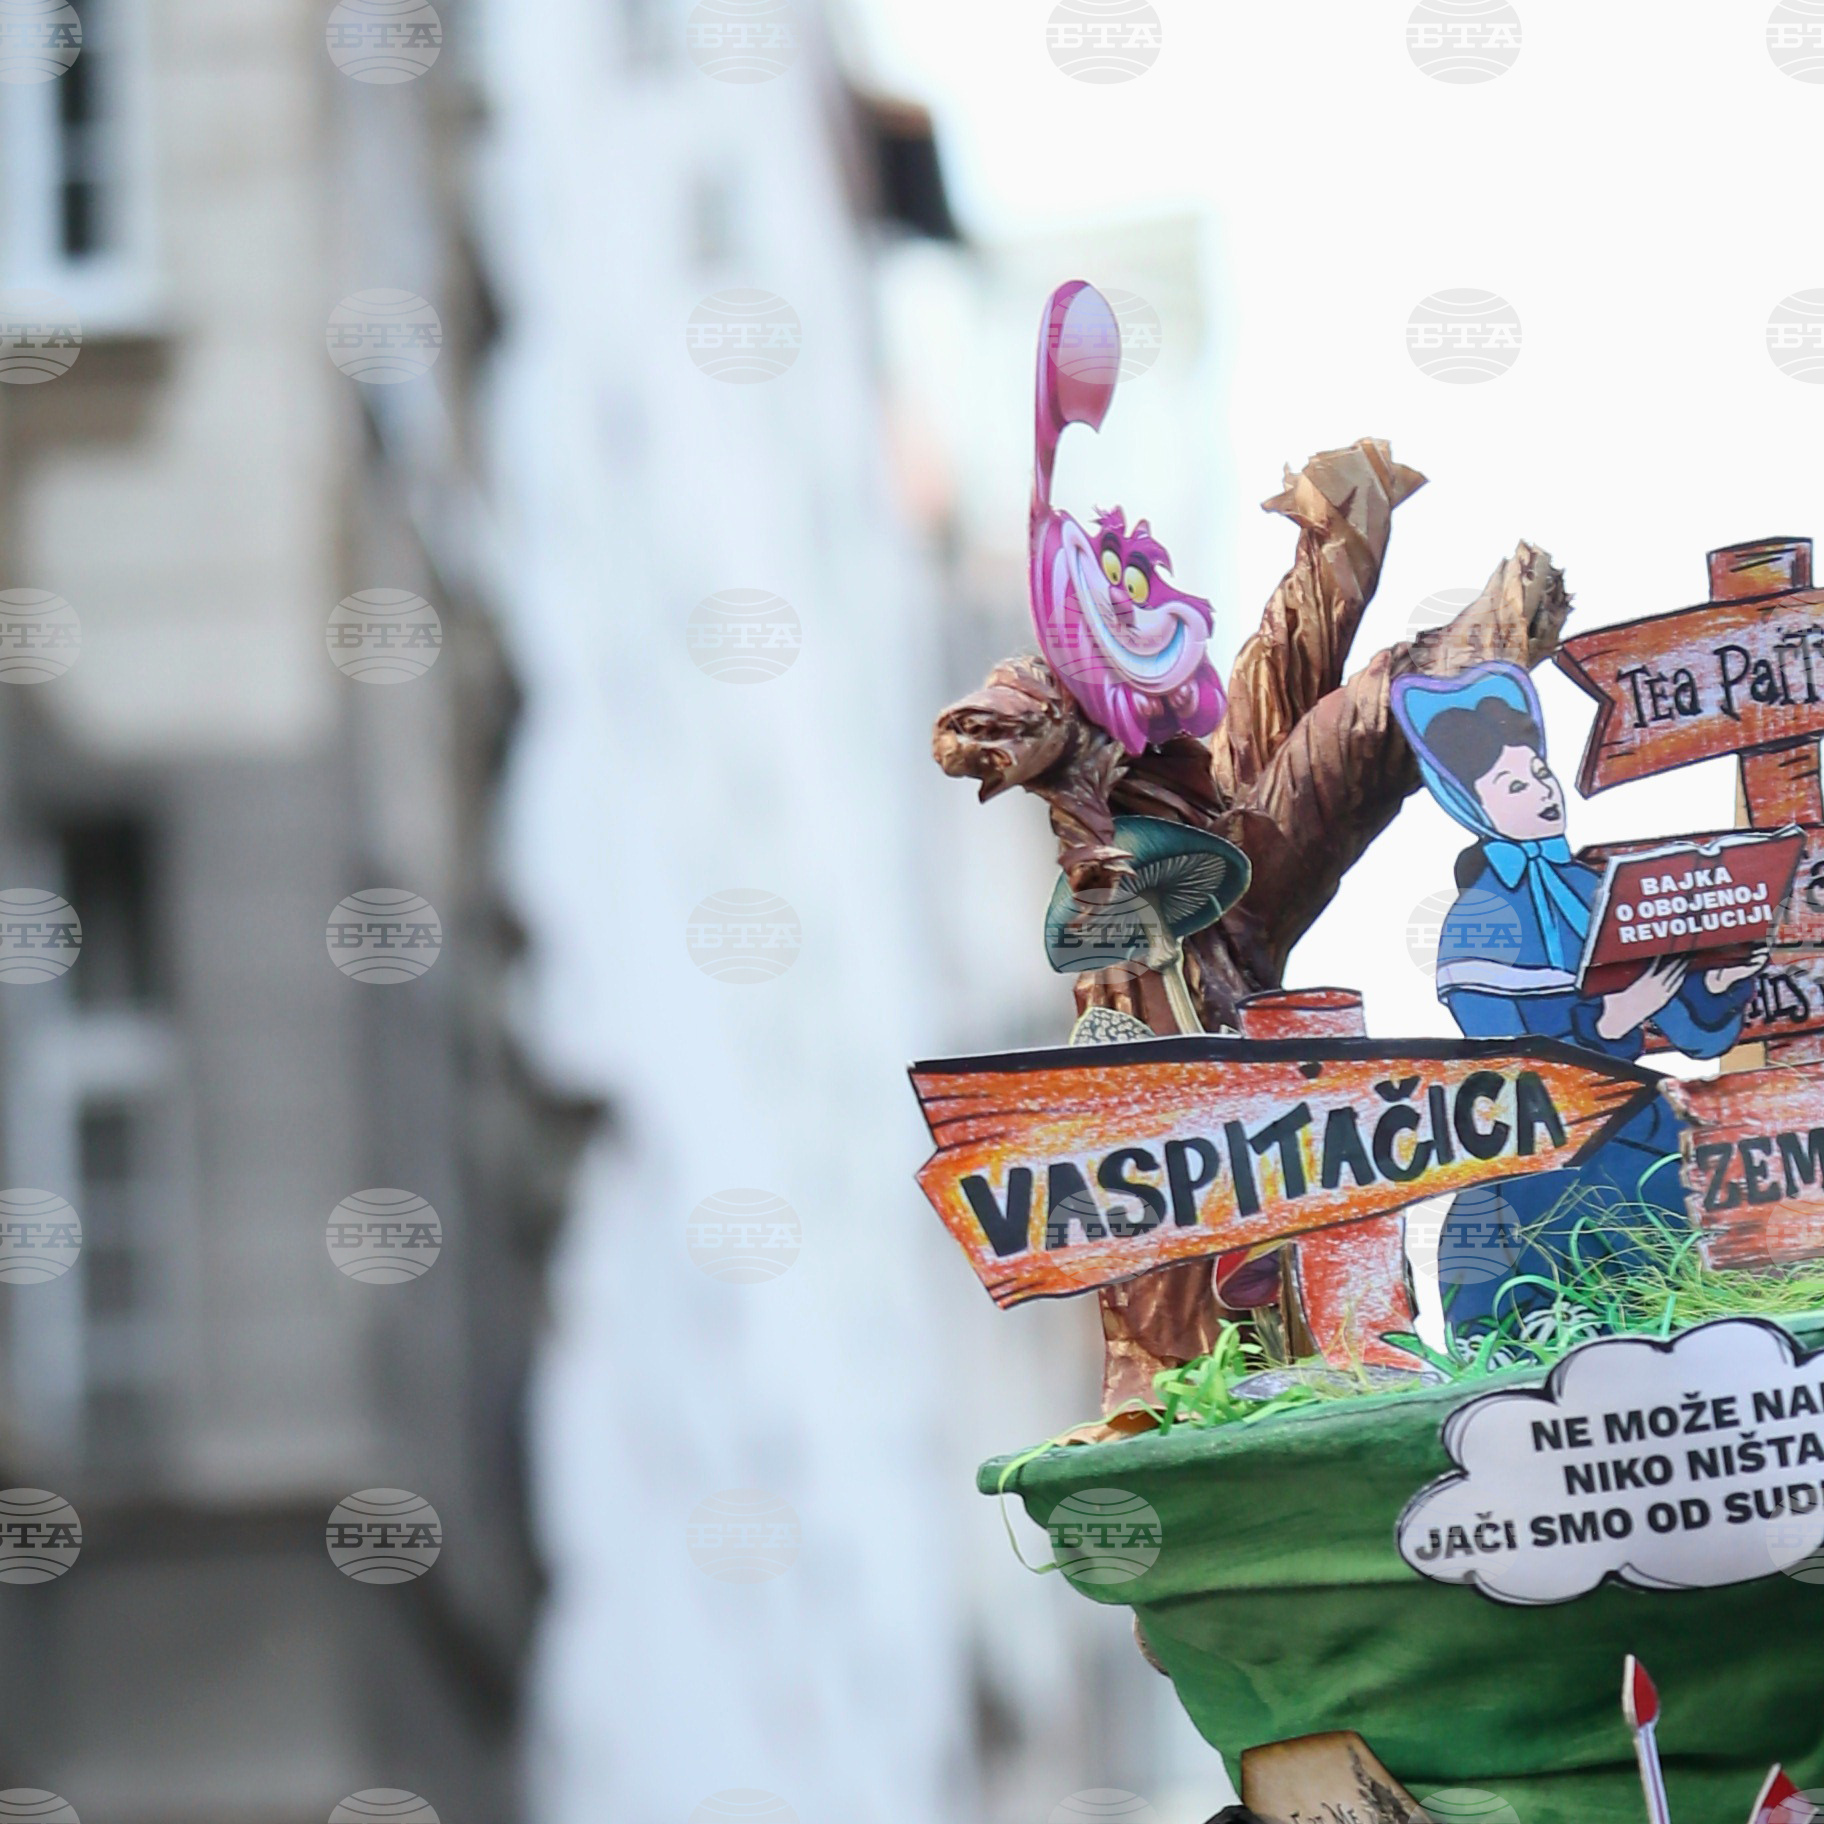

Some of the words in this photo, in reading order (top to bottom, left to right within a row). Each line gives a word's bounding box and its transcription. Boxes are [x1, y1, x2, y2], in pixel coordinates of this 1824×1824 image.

[1640, 866, 1733, 896] BAJKA
[1616, 903, 1634, 922] O
[1637, 883, 1768, 919] OBOJENOJ
[1618, 904, 1773, 943] REVOLUCIJI
[961, 1069, 1567, 1257] VASPITAČICA
[1531, 1416, 1593, 1452] NE
[1604, 1391, 1740, 1445] MOŽE
[1564, 1454, 1673, 1496] NIKO
[1415, 1511, 1518, 1562] JAČI
[1530, 1507, 1633, 1548] SMO
[1646, 1497, 1711, 1533] OD
